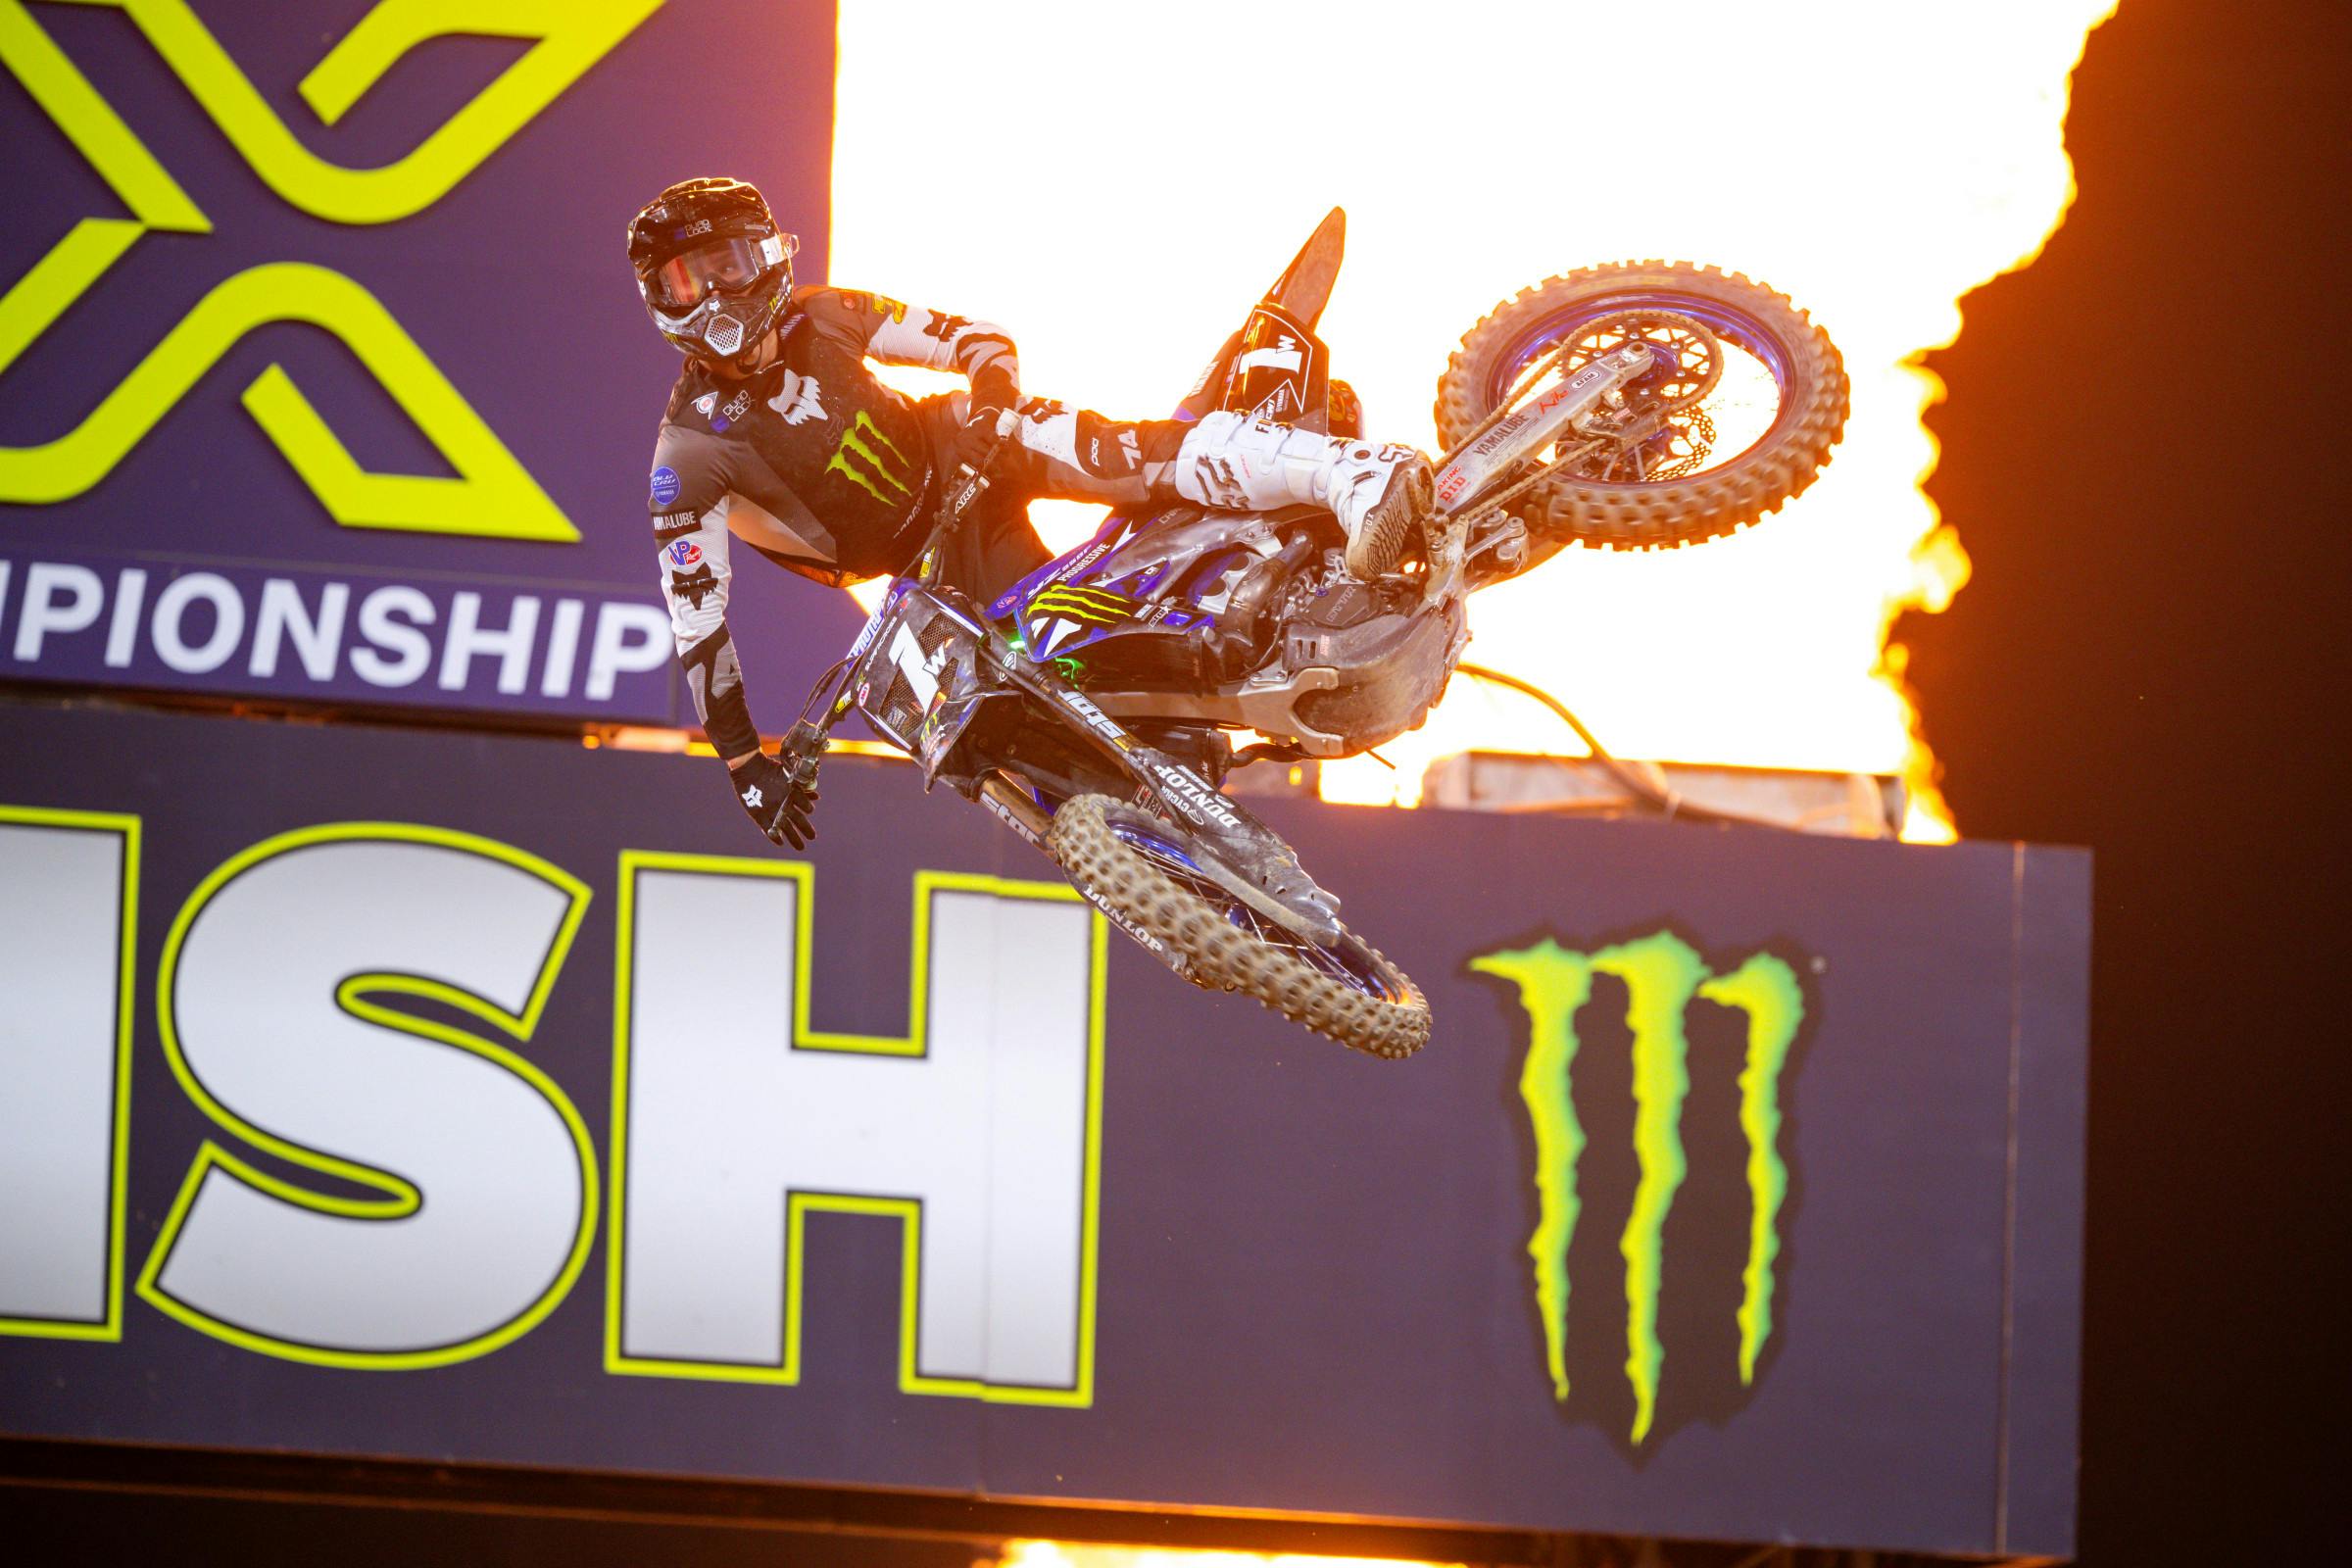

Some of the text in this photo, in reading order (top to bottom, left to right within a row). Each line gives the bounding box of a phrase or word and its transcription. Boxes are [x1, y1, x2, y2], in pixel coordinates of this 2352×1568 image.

[684, 219, 710, 230] QUAD
[686, 226, 712, 237] LOCK
[1239, 348, 1302, 374] 1
[1276, 334, 1296, 354] W
[722, 390, 749, 416] QUAD
[728, 397, 756, 421] LOCK
[1473, 414, 1530, 456] YAMALUBE
[1438, 466, 1461, 490] AKING
[1440, 476, 1466, 502] DID
[955, 483, 977, 514] ARC
[668, 540, 690, 565] VP
[1057, 543, 1111, 582] PROGRESSIVE
[0, 559, 674, 700] PIONSHIP
[888, 620, 947, 717] 1 W
[1152, 764, 1243, 828] DUNLOP
